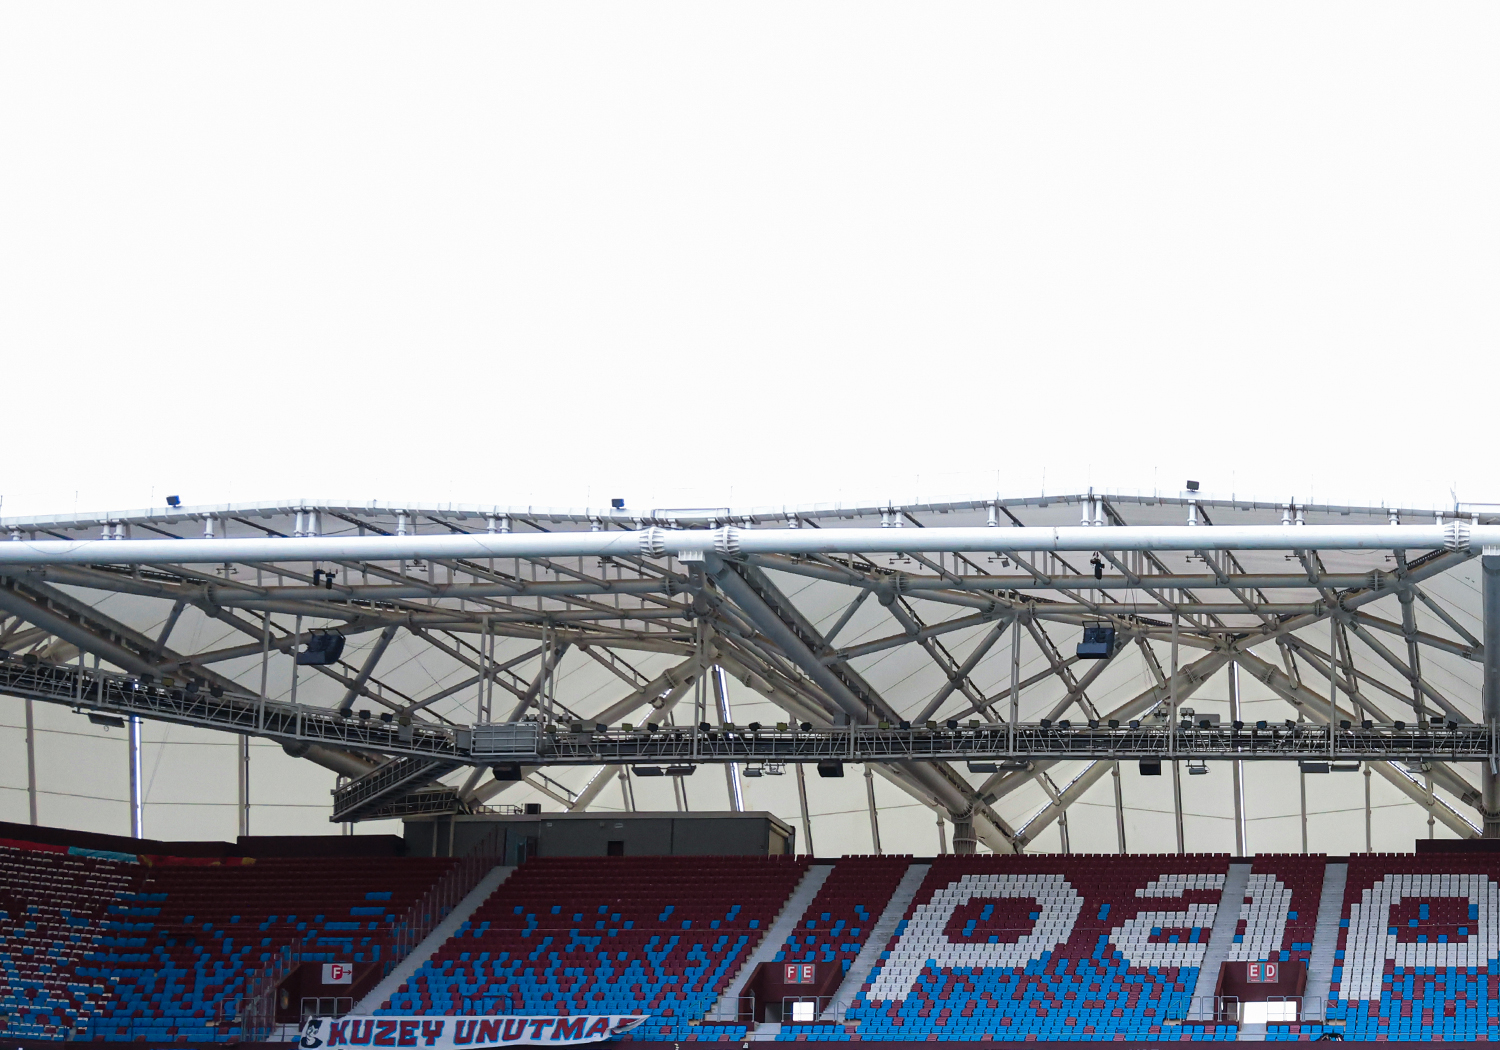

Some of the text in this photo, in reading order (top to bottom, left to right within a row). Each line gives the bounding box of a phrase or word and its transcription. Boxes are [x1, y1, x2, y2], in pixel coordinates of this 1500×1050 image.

[333, 967, 342, 979] F
[787, 966, 795, 978] F
[803, 966, 812, 978] E
[1250, 964, 1258, 977] E
[1266, 964, 1275, 977] D
[326, 1019, 446, 1048] KUZEY
